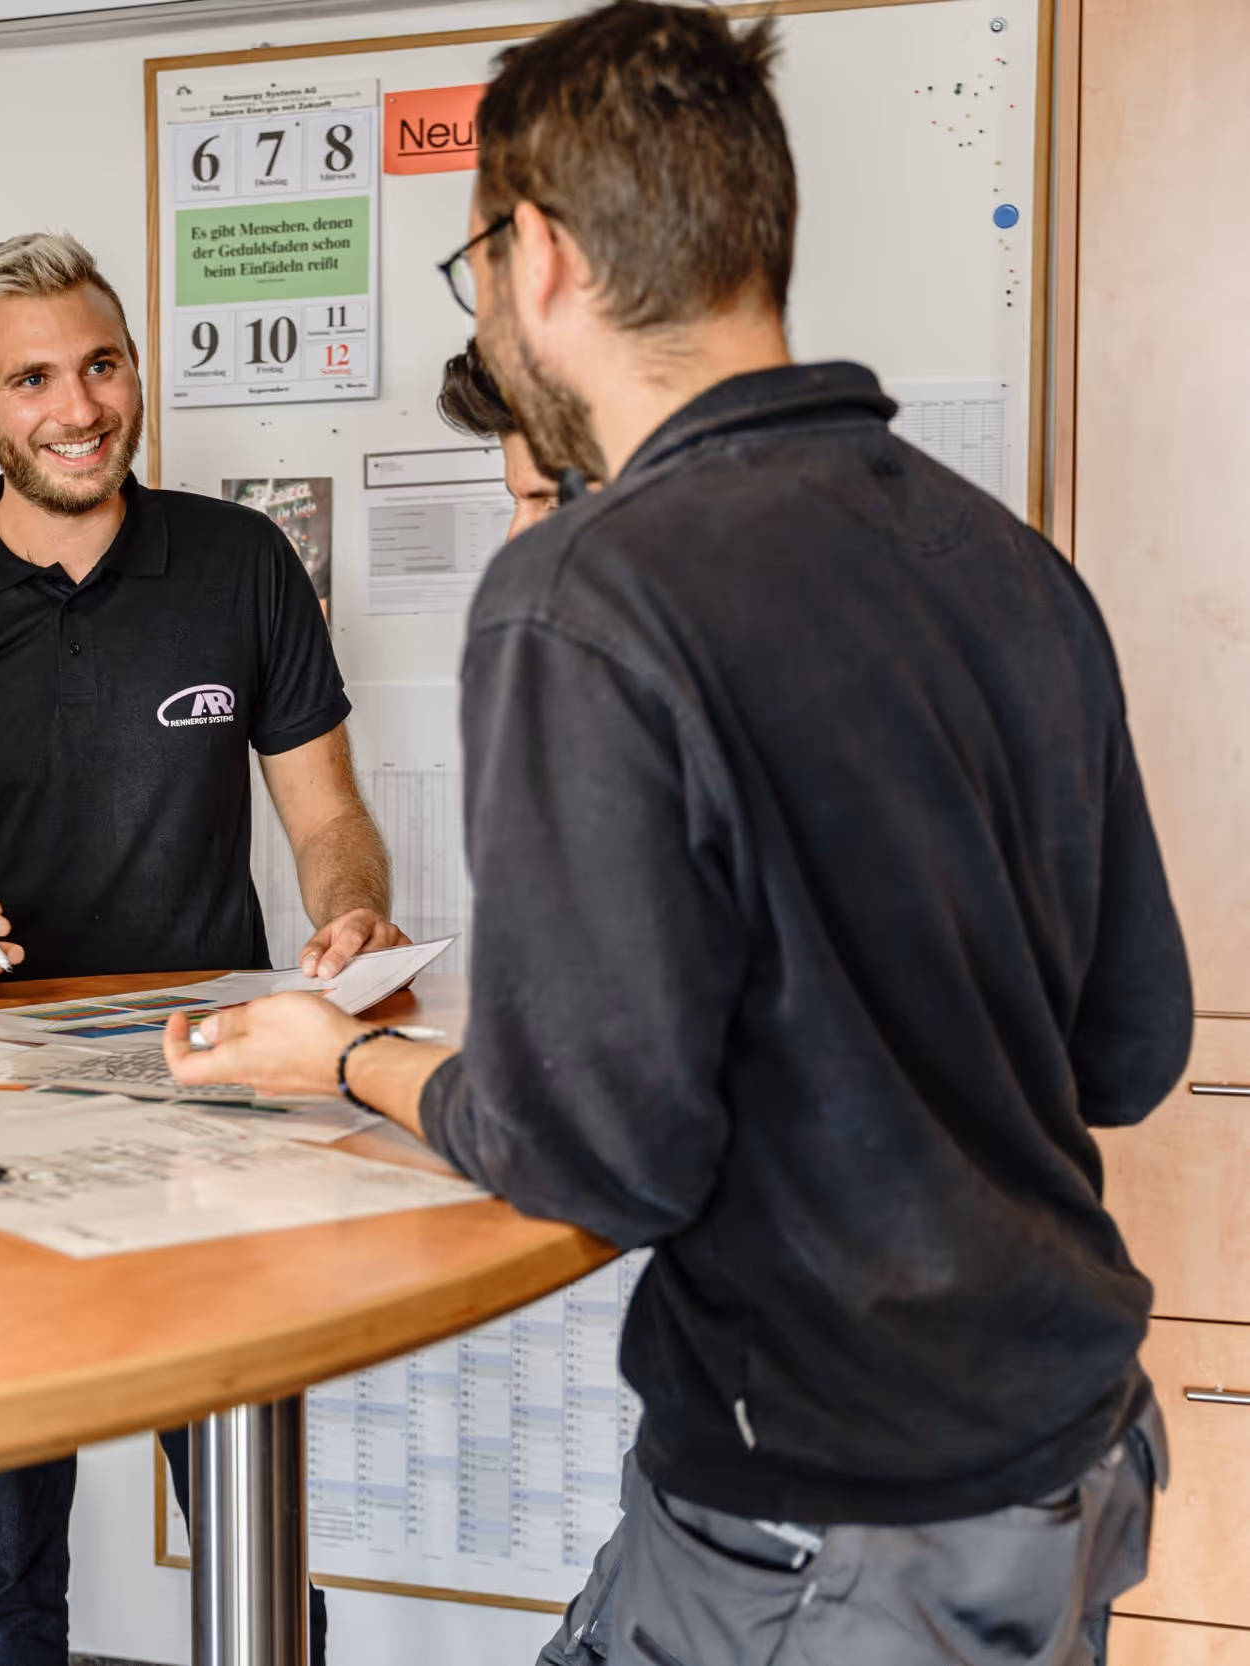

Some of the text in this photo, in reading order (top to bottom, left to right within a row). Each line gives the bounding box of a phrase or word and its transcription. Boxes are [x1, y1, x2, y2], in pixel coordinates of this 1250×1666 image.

[400, 117, 479, 150] Neu
[192, 124, 354, 183] 6 7 8
[191, 226, 207, 240] Es
[211, 225, 235, 241] gibt
[313, 217, 353, 231] denen
[193, 237, 351, 259] der Geduldsfaden schon
[204, 256, 338, 278] beim Einfädeln reißt
[327, 306, 347, 328] 11
[191, 316, 350, 368] 9 10 12
[170, 715, 234, 727] RENNERGY SYSTEMS
